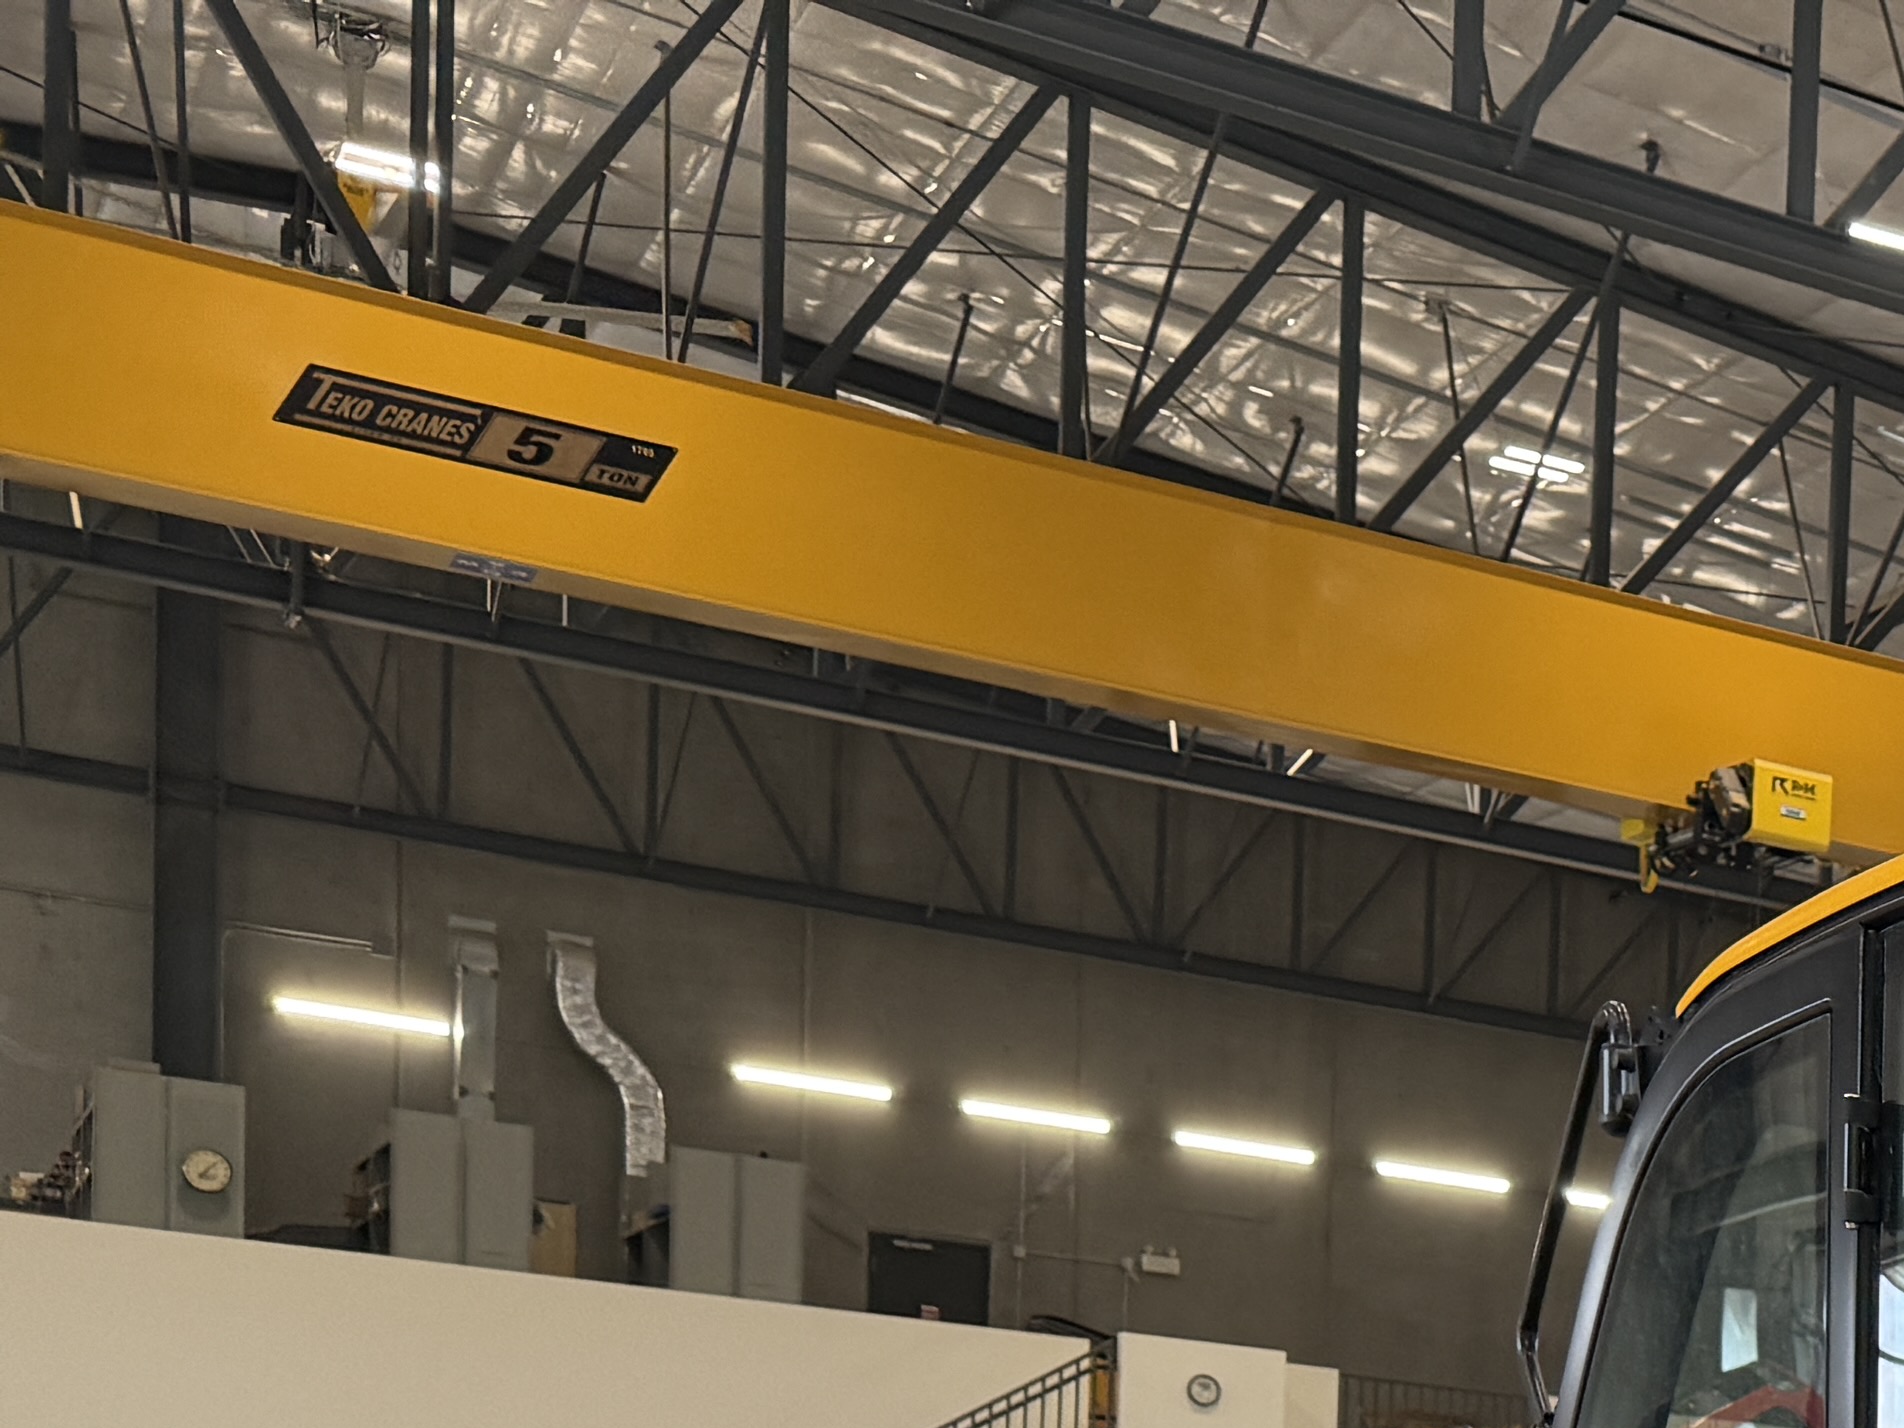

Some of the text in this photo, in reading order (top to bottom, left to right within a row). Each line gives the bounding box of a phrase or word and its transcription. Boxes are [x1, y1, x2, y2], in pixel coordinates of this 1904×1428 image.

[306, 371, 475, 445] TEKO CRANES
[506, 426, 562, 466] 5
[598, 468, 640, 487] TON
